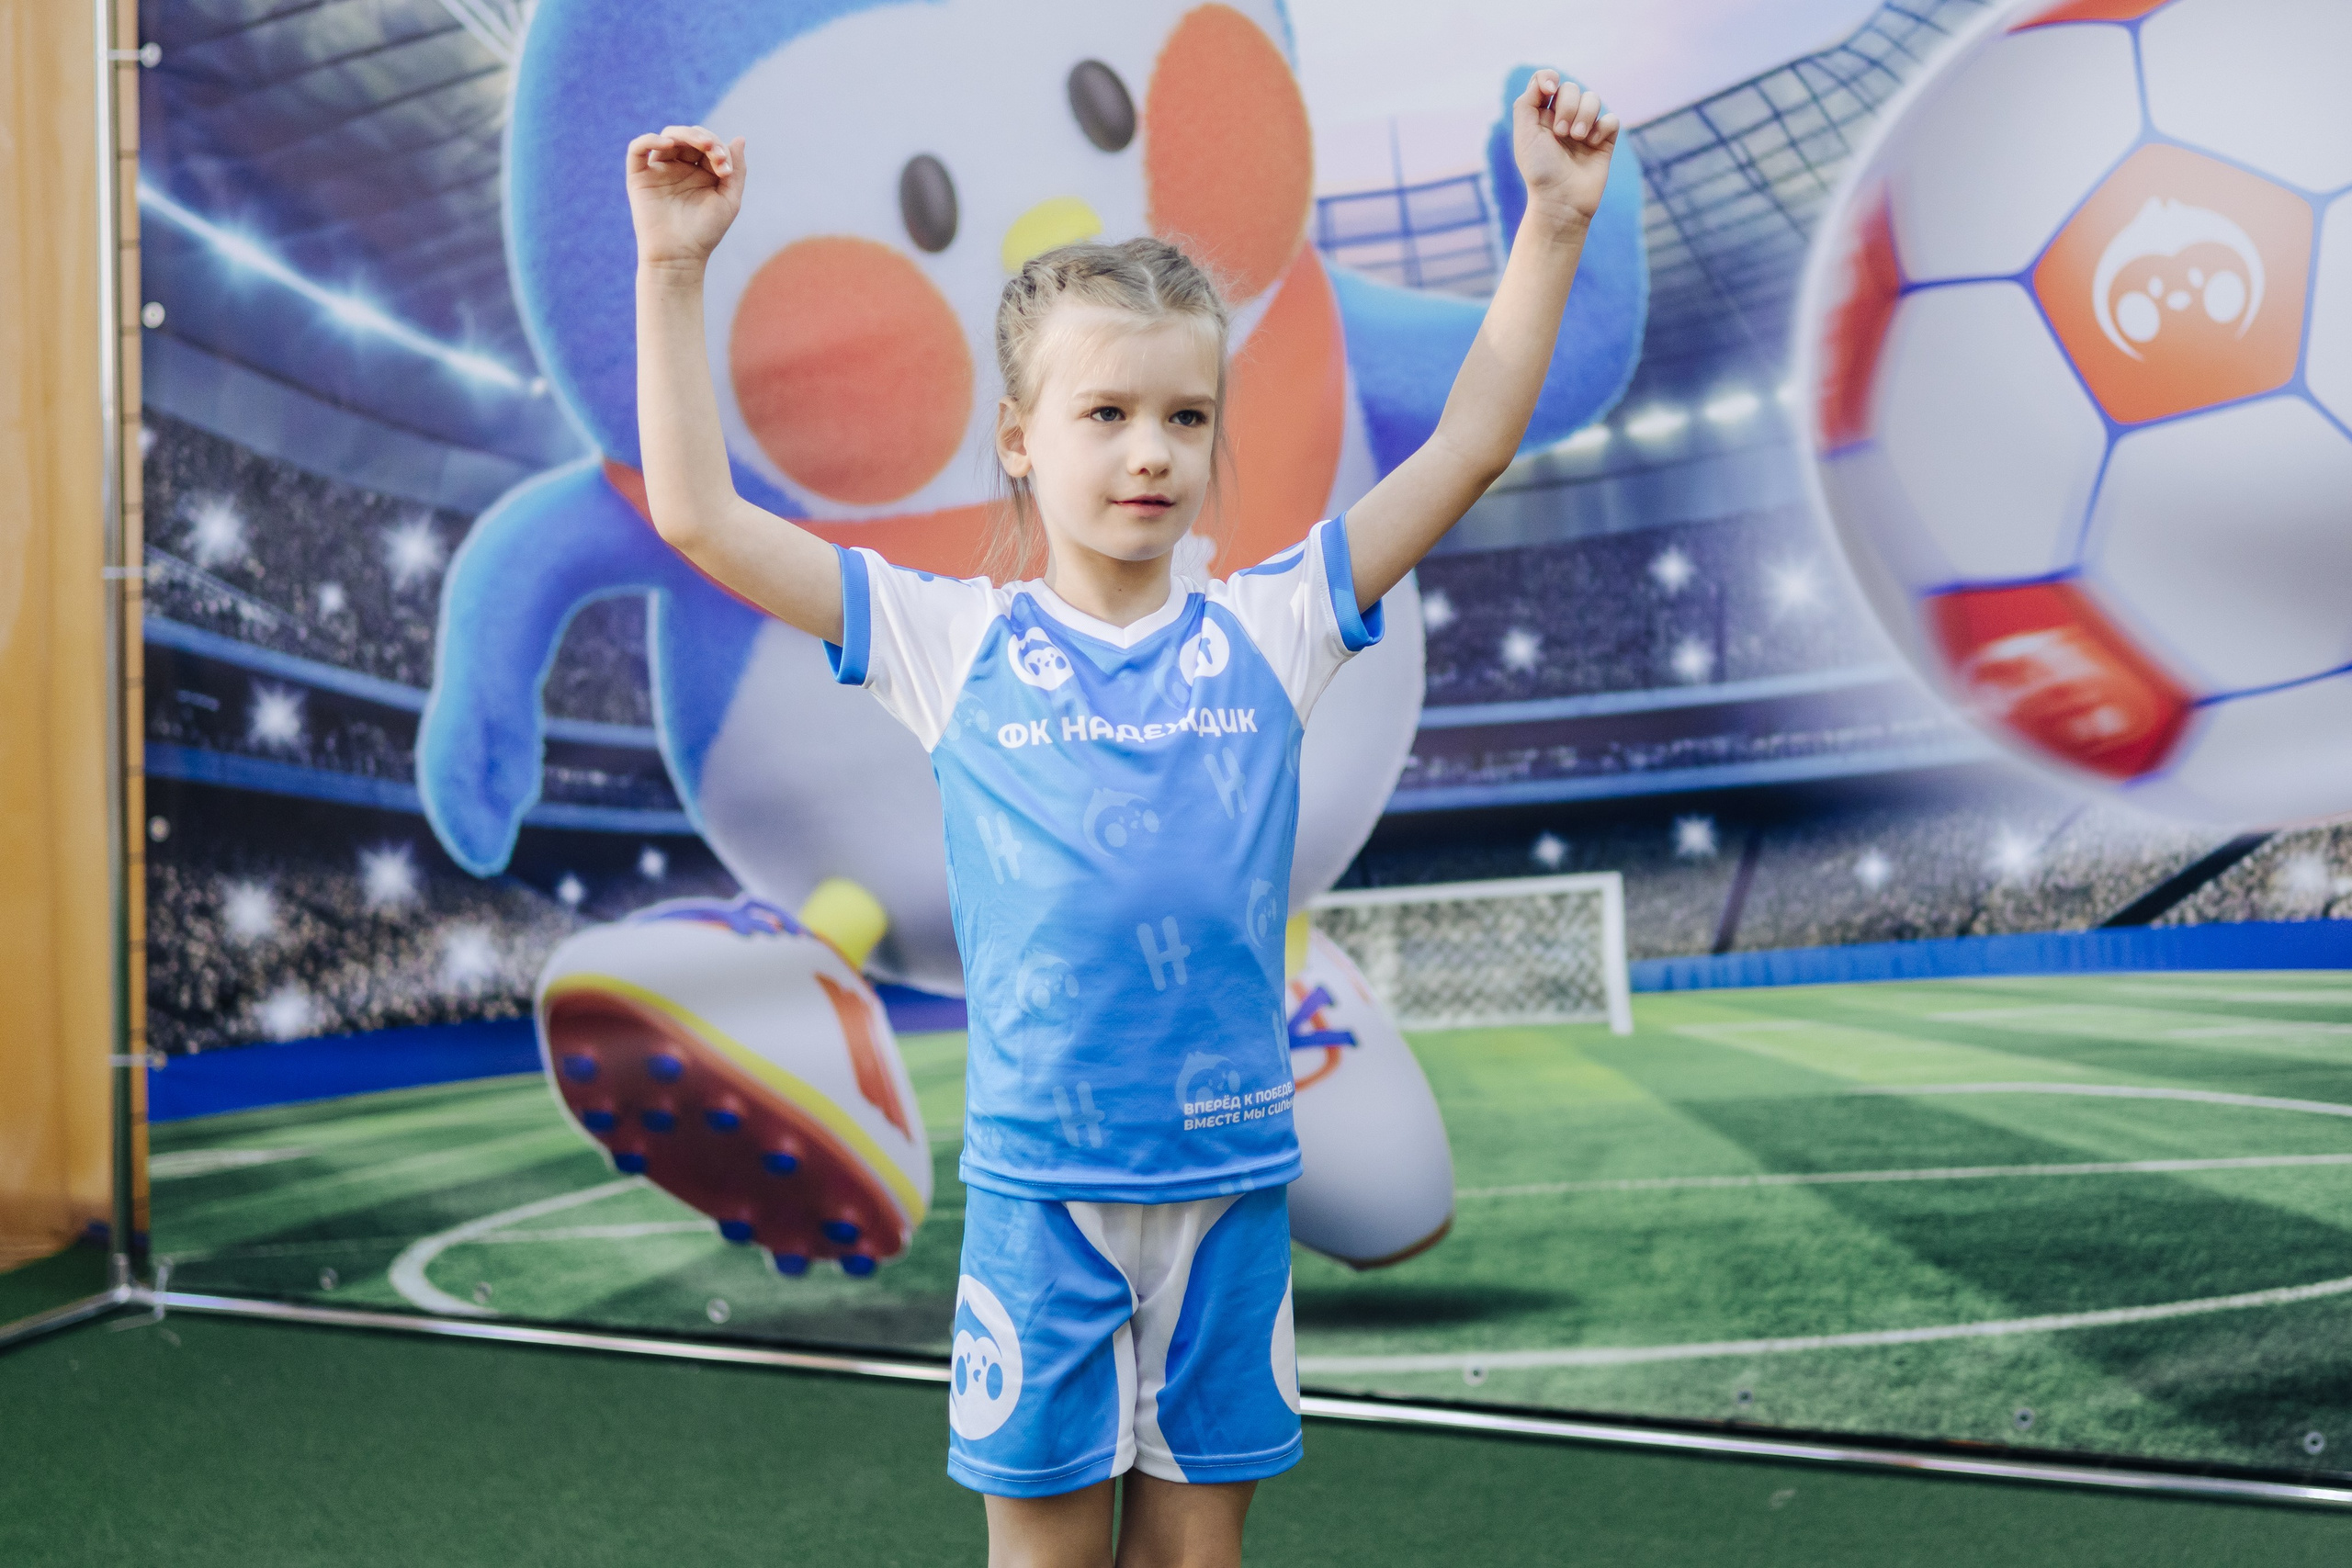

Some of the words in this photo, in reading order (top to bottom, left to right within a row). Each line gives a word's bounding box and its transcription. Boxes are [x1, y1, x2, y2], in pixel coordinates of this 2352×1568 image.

[998, 718, 1053, 749] ФК
[1061, 707, 1259, 743] НАДЕЖДИК
[1183, 1095, 1240, 1116] ВПЕРЁД
[1244, 1093, 1252, 1106] К
[1183, 1111, 1240, 1131] ВМЕСТЕ
[1243, 1108, 1265, 1122] МЫ
